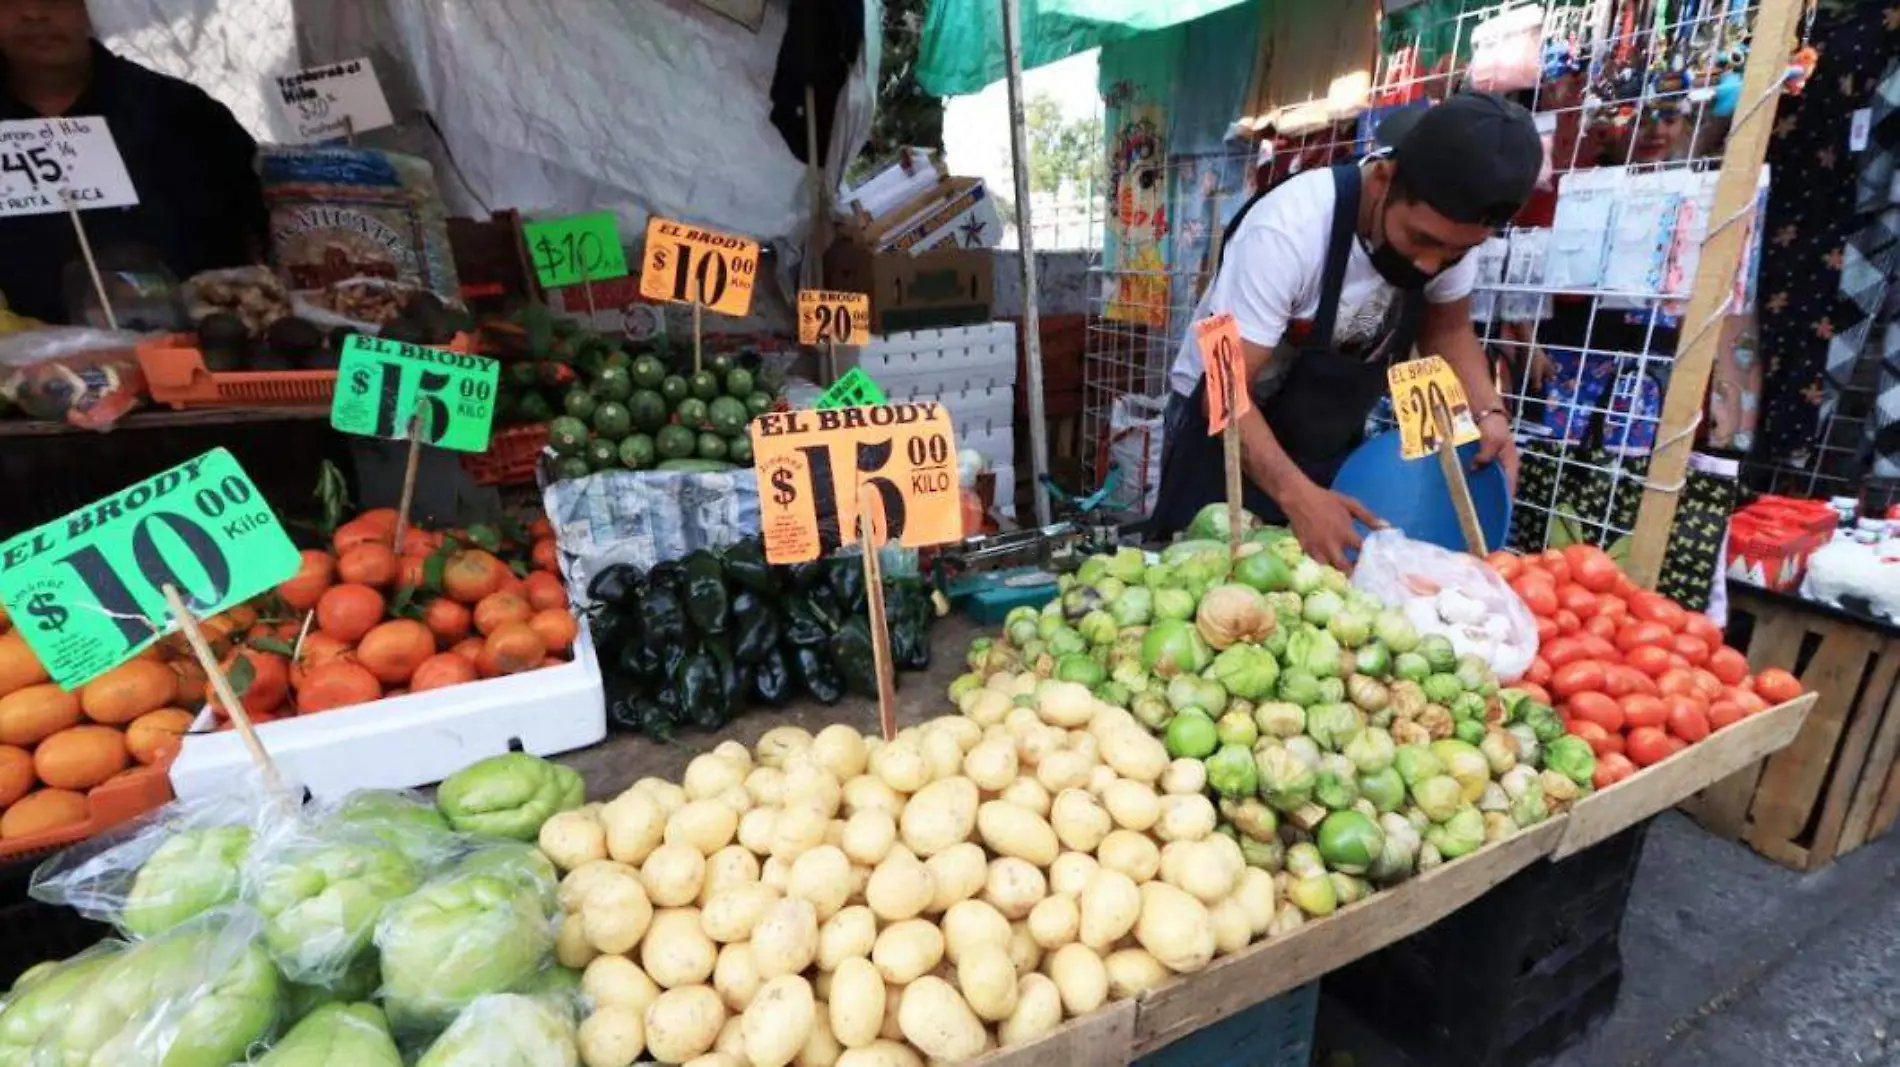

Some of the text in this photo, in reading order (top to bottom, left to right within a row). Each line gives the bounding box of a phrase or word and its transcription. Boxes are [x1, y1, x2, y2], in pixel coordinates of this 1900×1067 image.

[658, 224, 681, 237] EL
[685, 230, 746, 251] BRODY
[673, 243, 728, 306] 10
[731, 256, 754, 275] 00
[815, 304, 852, 343] 20
[354, 335, 391, 354] EL
[399, 345, 495, 373] BRODY
[350, 369, 371, 397] $
[374, 360, 451, 444] 15
[460, 377, 491, 401] 00
[757, 402, 939, 437] EL BRODY
[771, 465, 797, 511] $
[795, 437, 907, 557] 15
[907, 433, 949, 467] 00
[911, 472, 949, 495] KILO
[1, 454, 210, 573] EL BRODY
[222, 510, 271, 541] Kilo
[26, 475, 251, 657] $ 10 00
